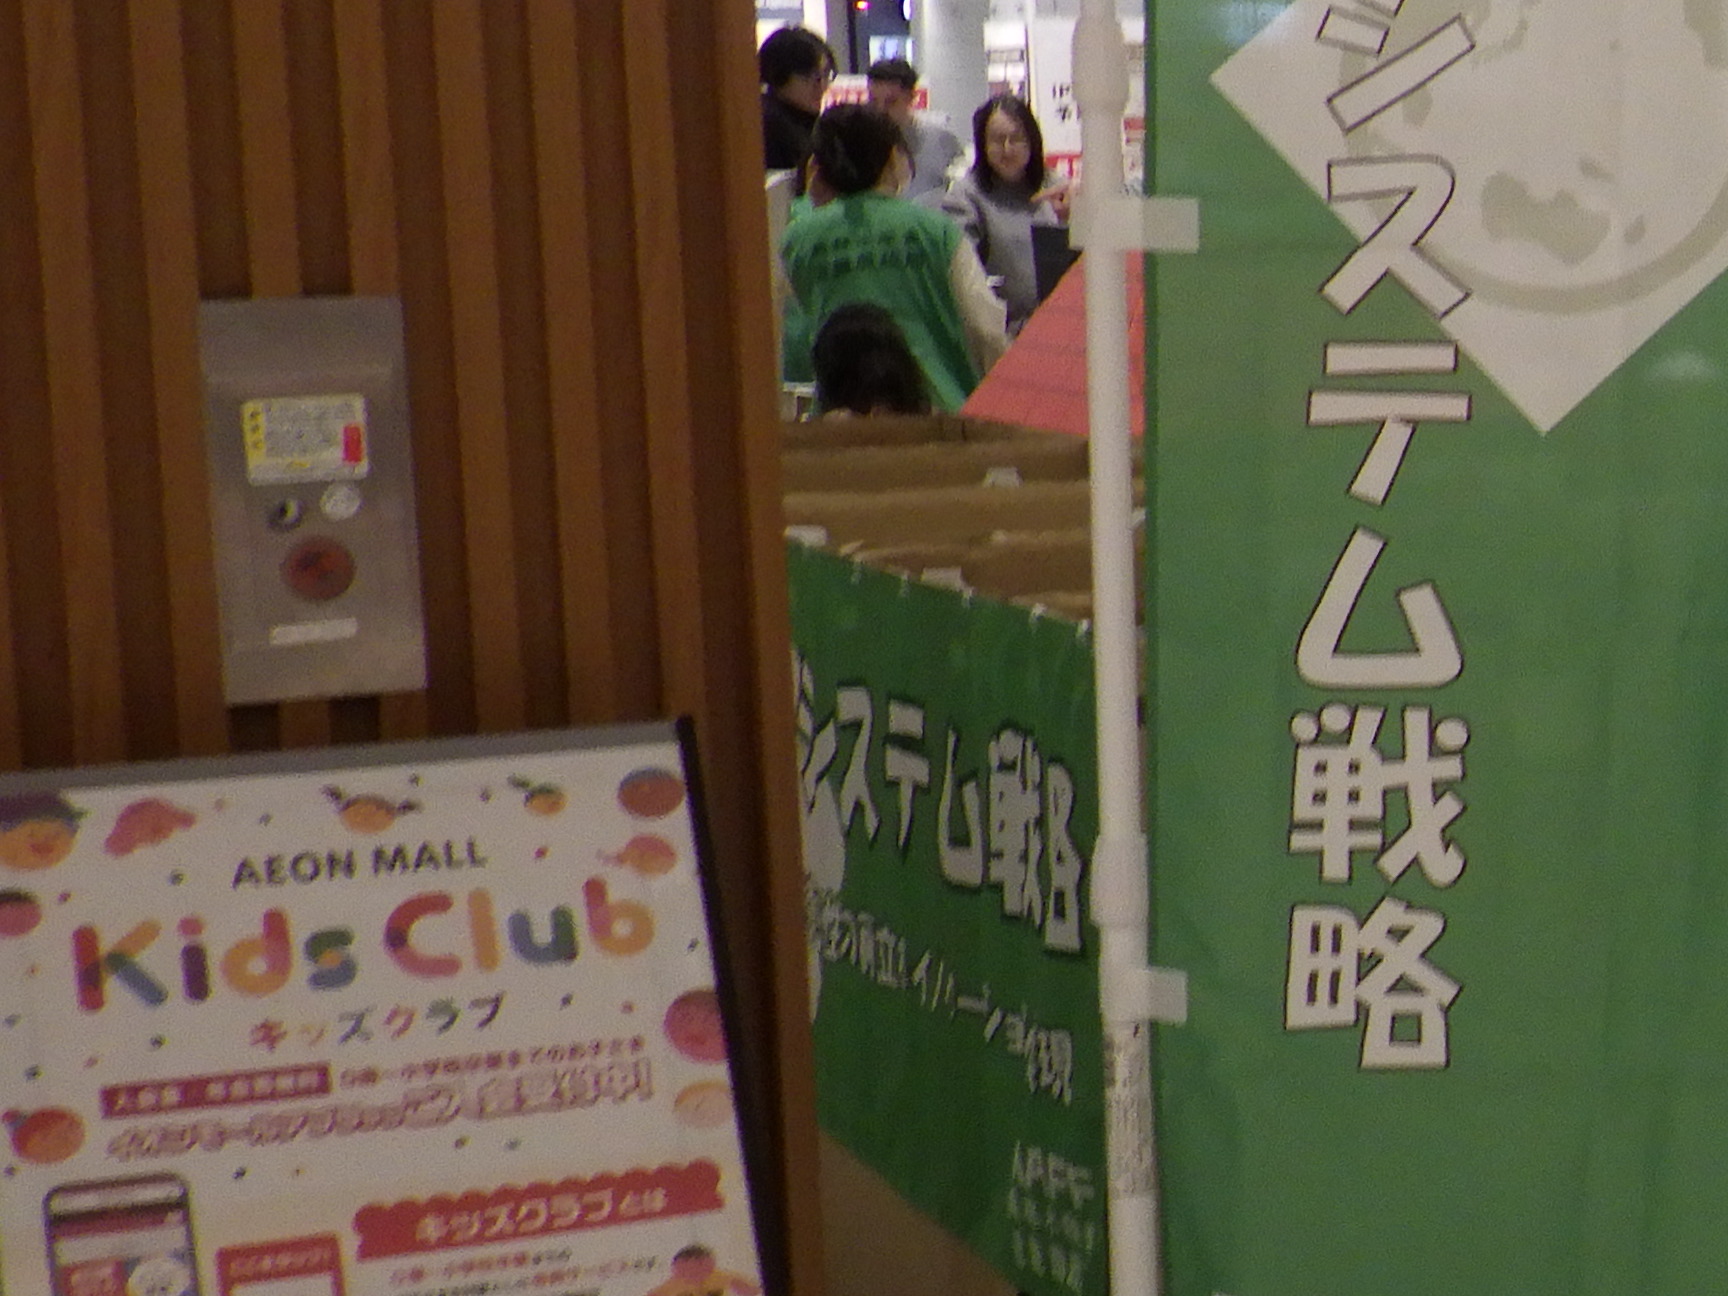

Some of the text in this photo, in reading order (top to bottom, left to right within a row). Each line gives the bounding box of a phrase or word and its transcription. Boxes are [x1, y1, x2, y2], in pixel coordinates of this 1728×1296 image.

[231, 836, 490, 892] AEON MALL
[68, 877, 657, 1010] Kids Club
[249, 994, 506, 1051] キッズクラブ
